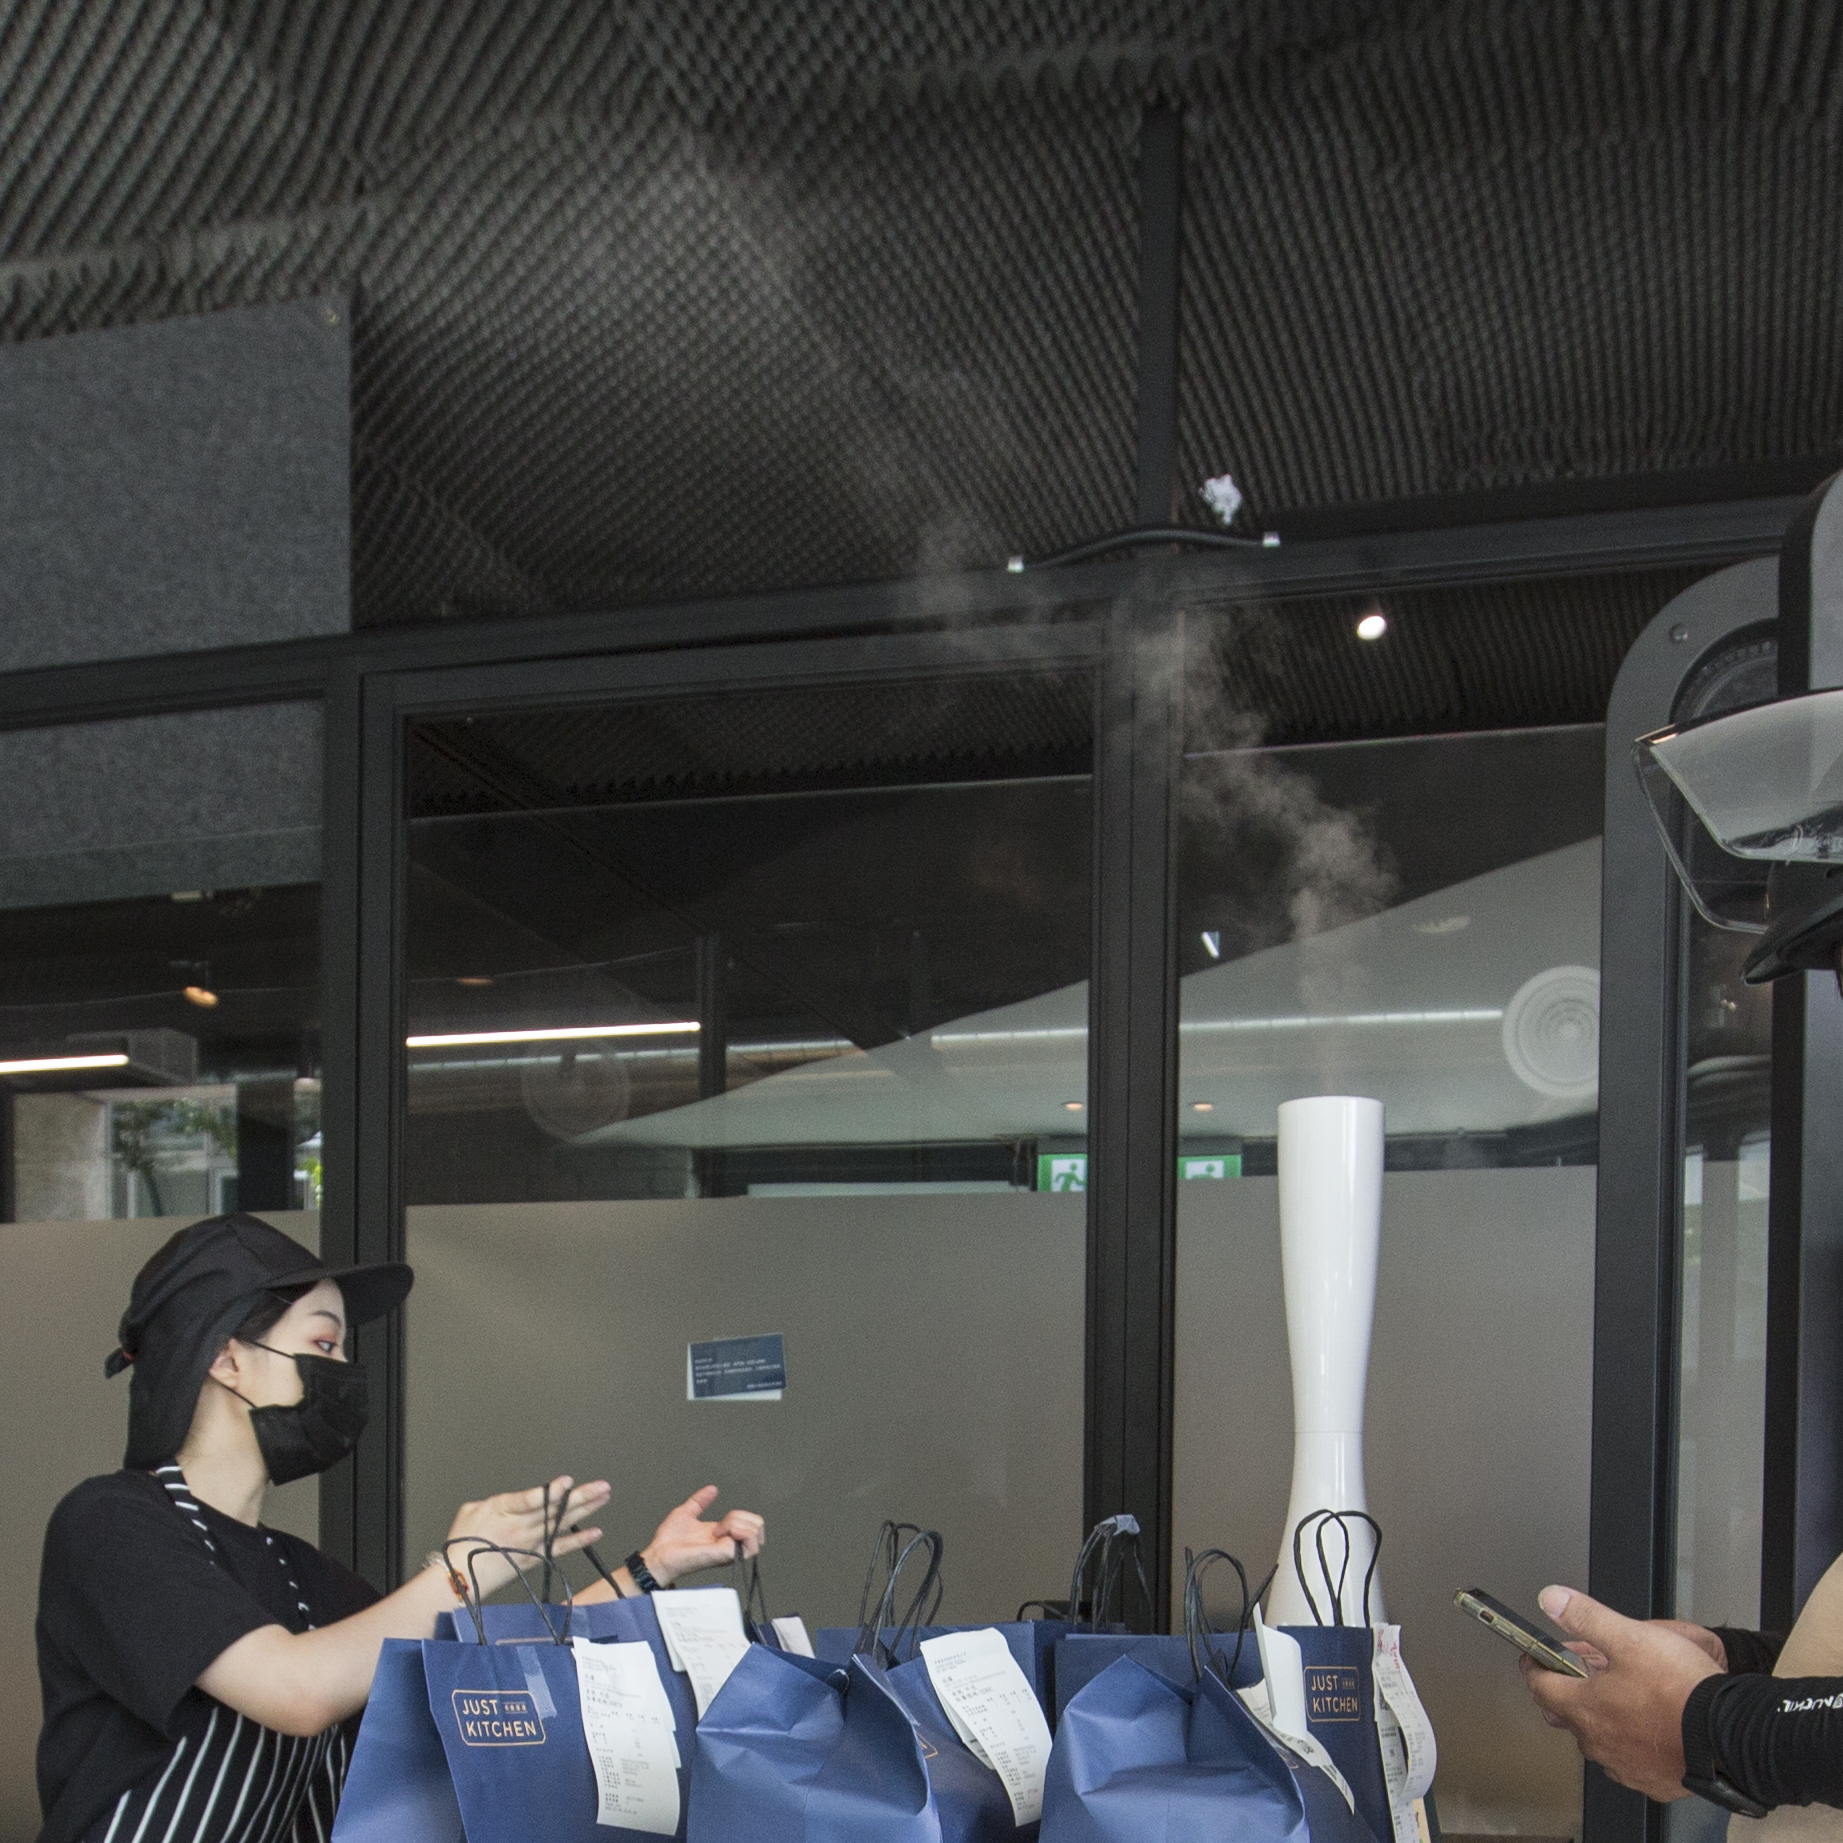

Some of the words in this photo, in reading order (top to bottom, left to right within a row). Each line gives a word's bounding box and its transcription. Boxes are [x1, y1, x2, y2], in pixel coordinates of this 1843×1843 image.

[1311, 1675, 1339, 1691] JUST
[462, 1699, 498, 1716] JUST
[1313, 1697, 1358, 1714] KITCHEN
[465, 1721, 537, 1738] KITCHEN
